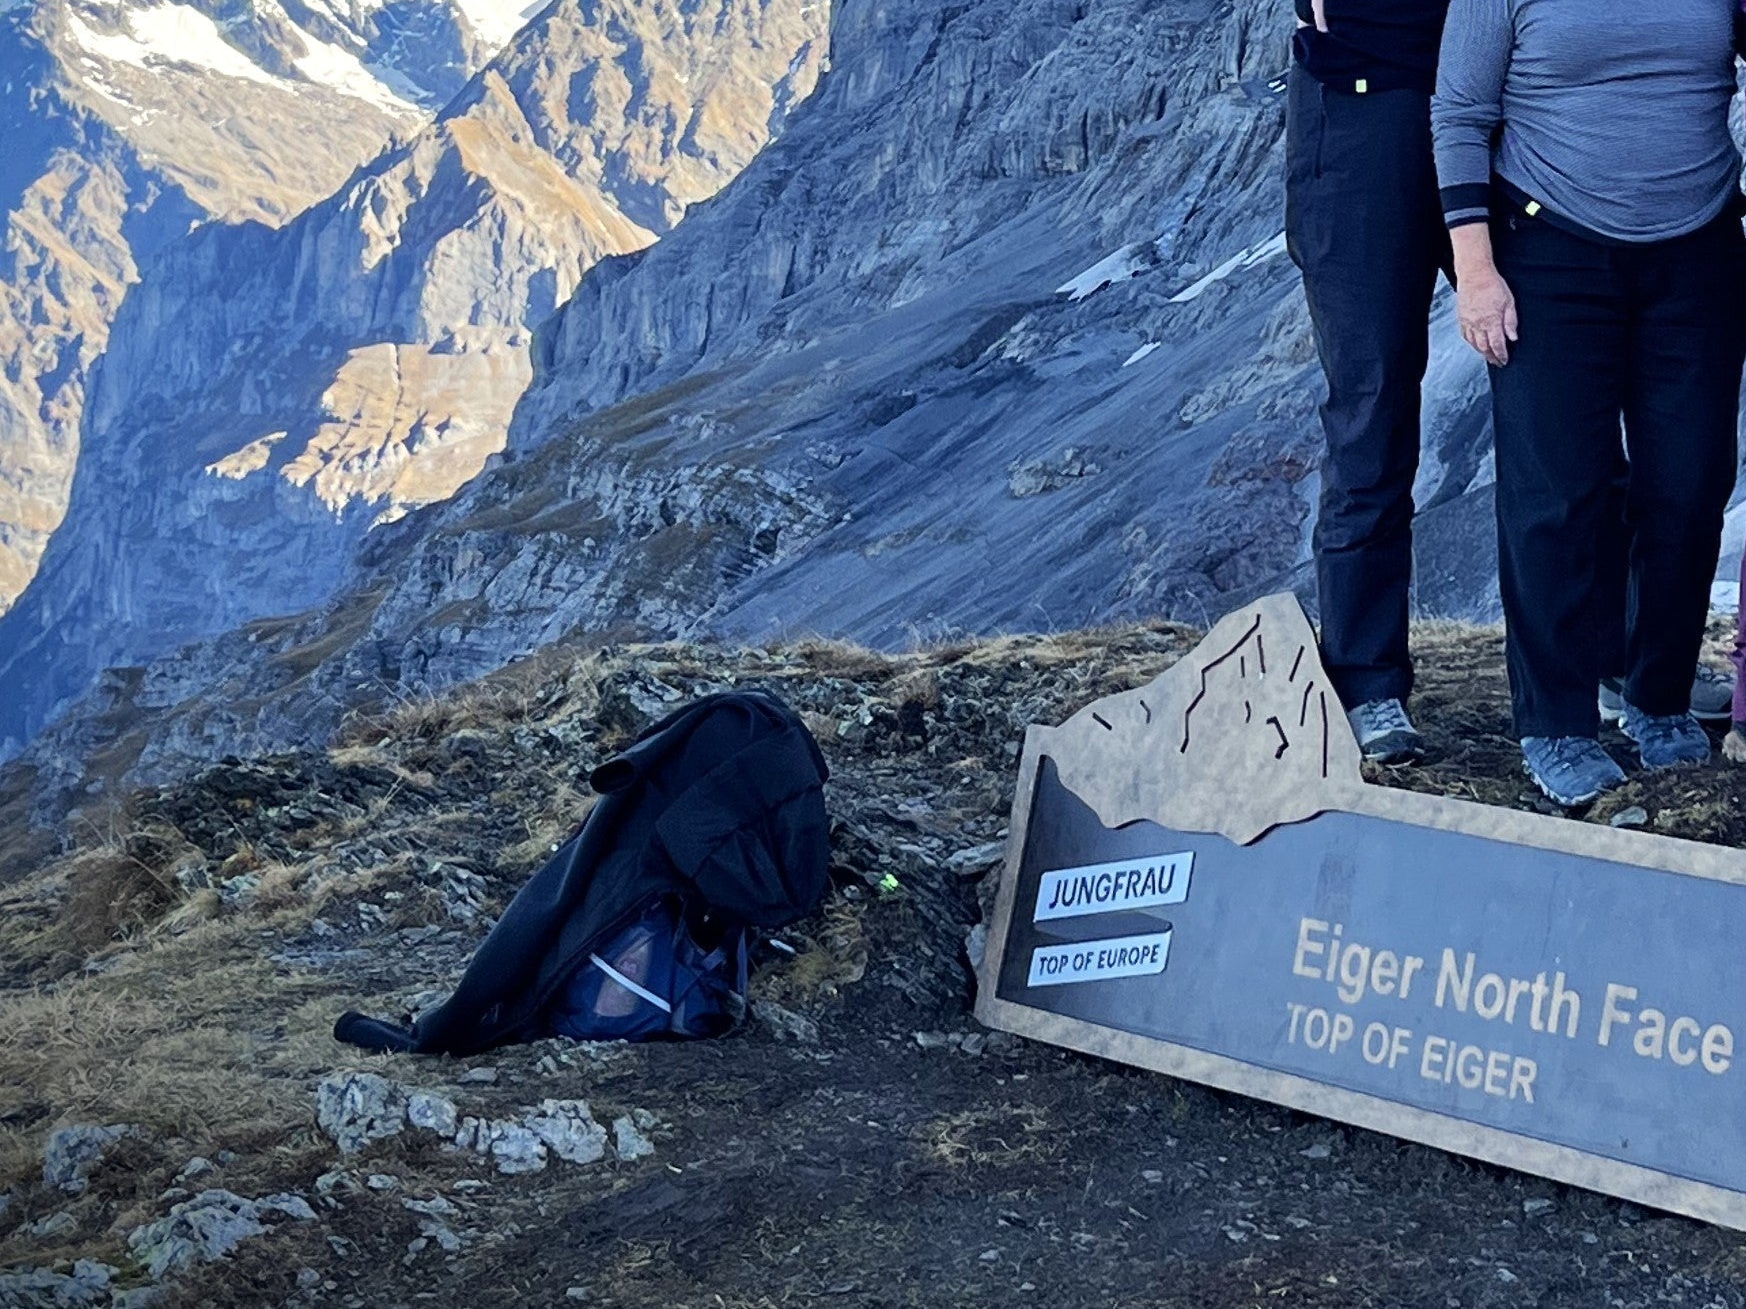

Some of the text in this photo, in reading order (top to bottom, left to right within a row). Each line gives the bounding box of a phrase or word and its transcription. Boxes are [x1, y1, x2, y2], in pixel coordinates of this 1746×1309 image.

[1049, 863, 1174, 909] JUNGFRAU
[1039, 942, 1161, 976] TOP OF EUROPE
[1292, 916, 1735, 1076] Eiger North Face
[1286, 1001, 1538, 1104] TOP OF EIGER
